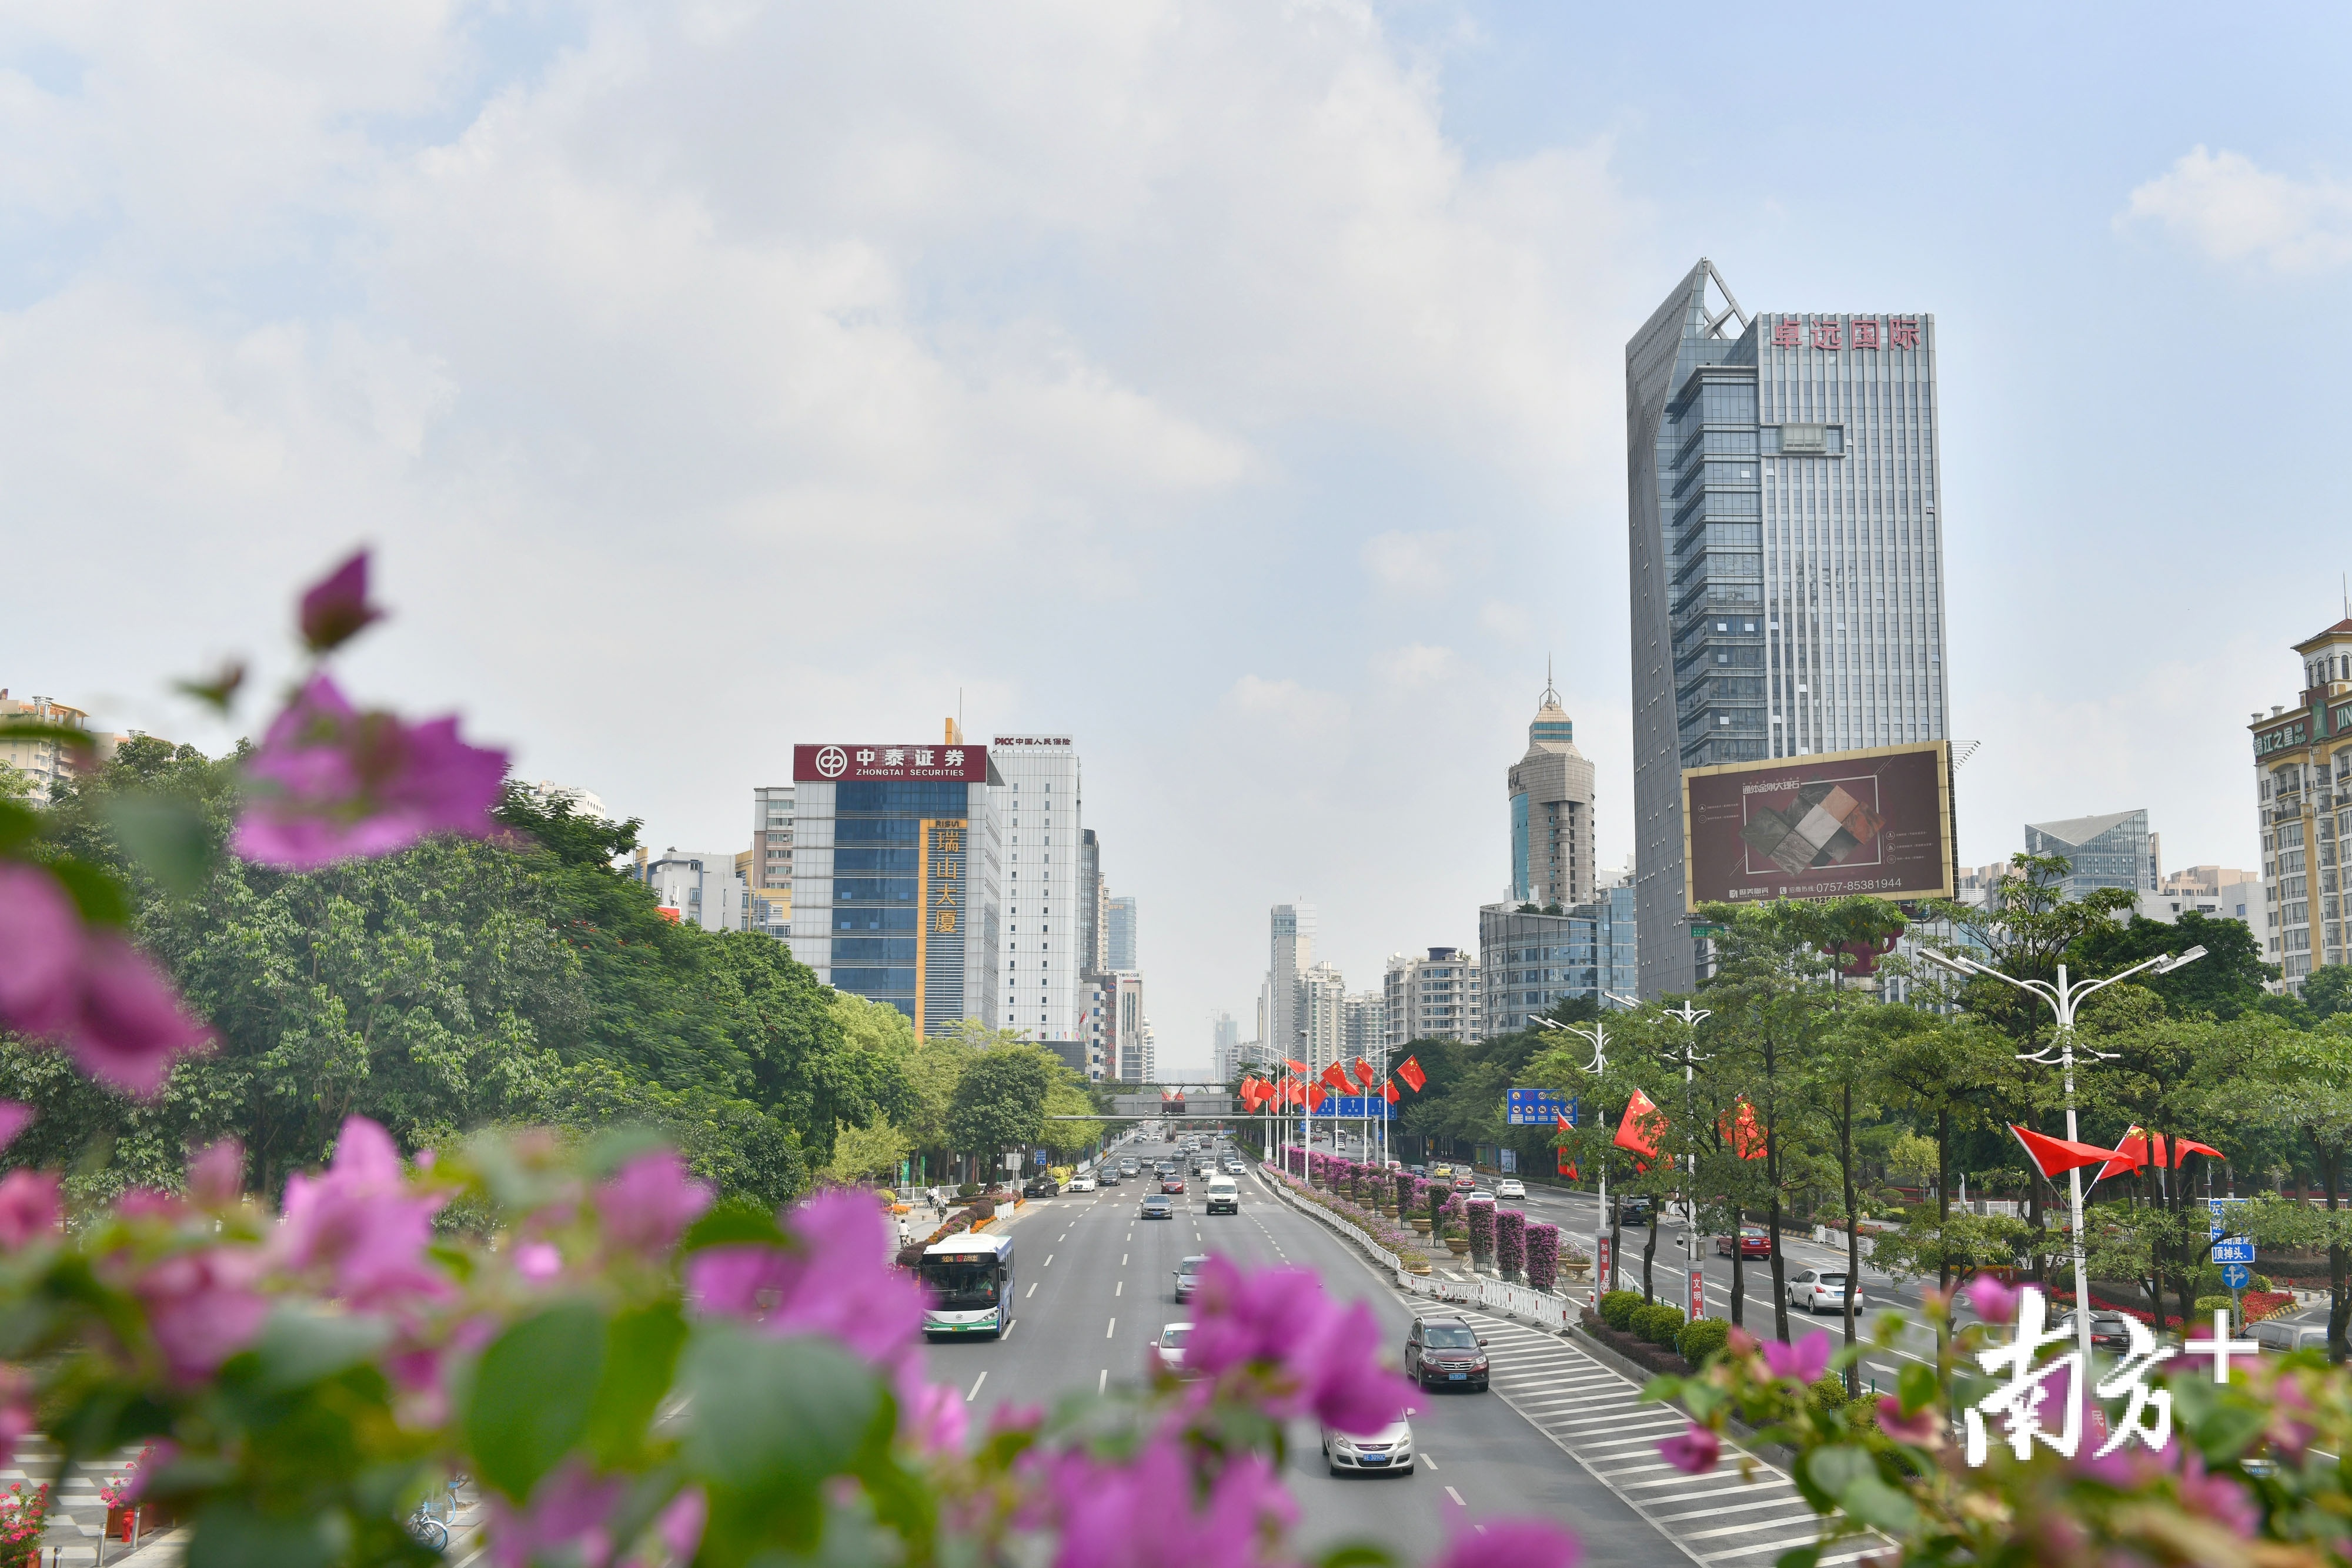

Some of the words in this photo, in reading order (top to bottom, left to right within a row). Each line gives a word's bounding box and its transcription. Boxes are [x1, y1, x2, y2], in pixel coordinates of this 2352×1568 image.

[1772, 318, 1920, 350] 卓远国际
[995, 737, 1014, 745] PICC
[2253, 727, 2293, 756] 锦江之星
[856, 748, 965, 767] 中泰证券
[1742, 780, 1800, 794] 通体金刚大理石
[933, 830, 960, 933] 瑞山大厦
[1816, 878, 1902, 893] 0757-85381944
[1601, 1243, 1608, 1263] 和谐
[1693, 1278, 1702, 1302] 文明
